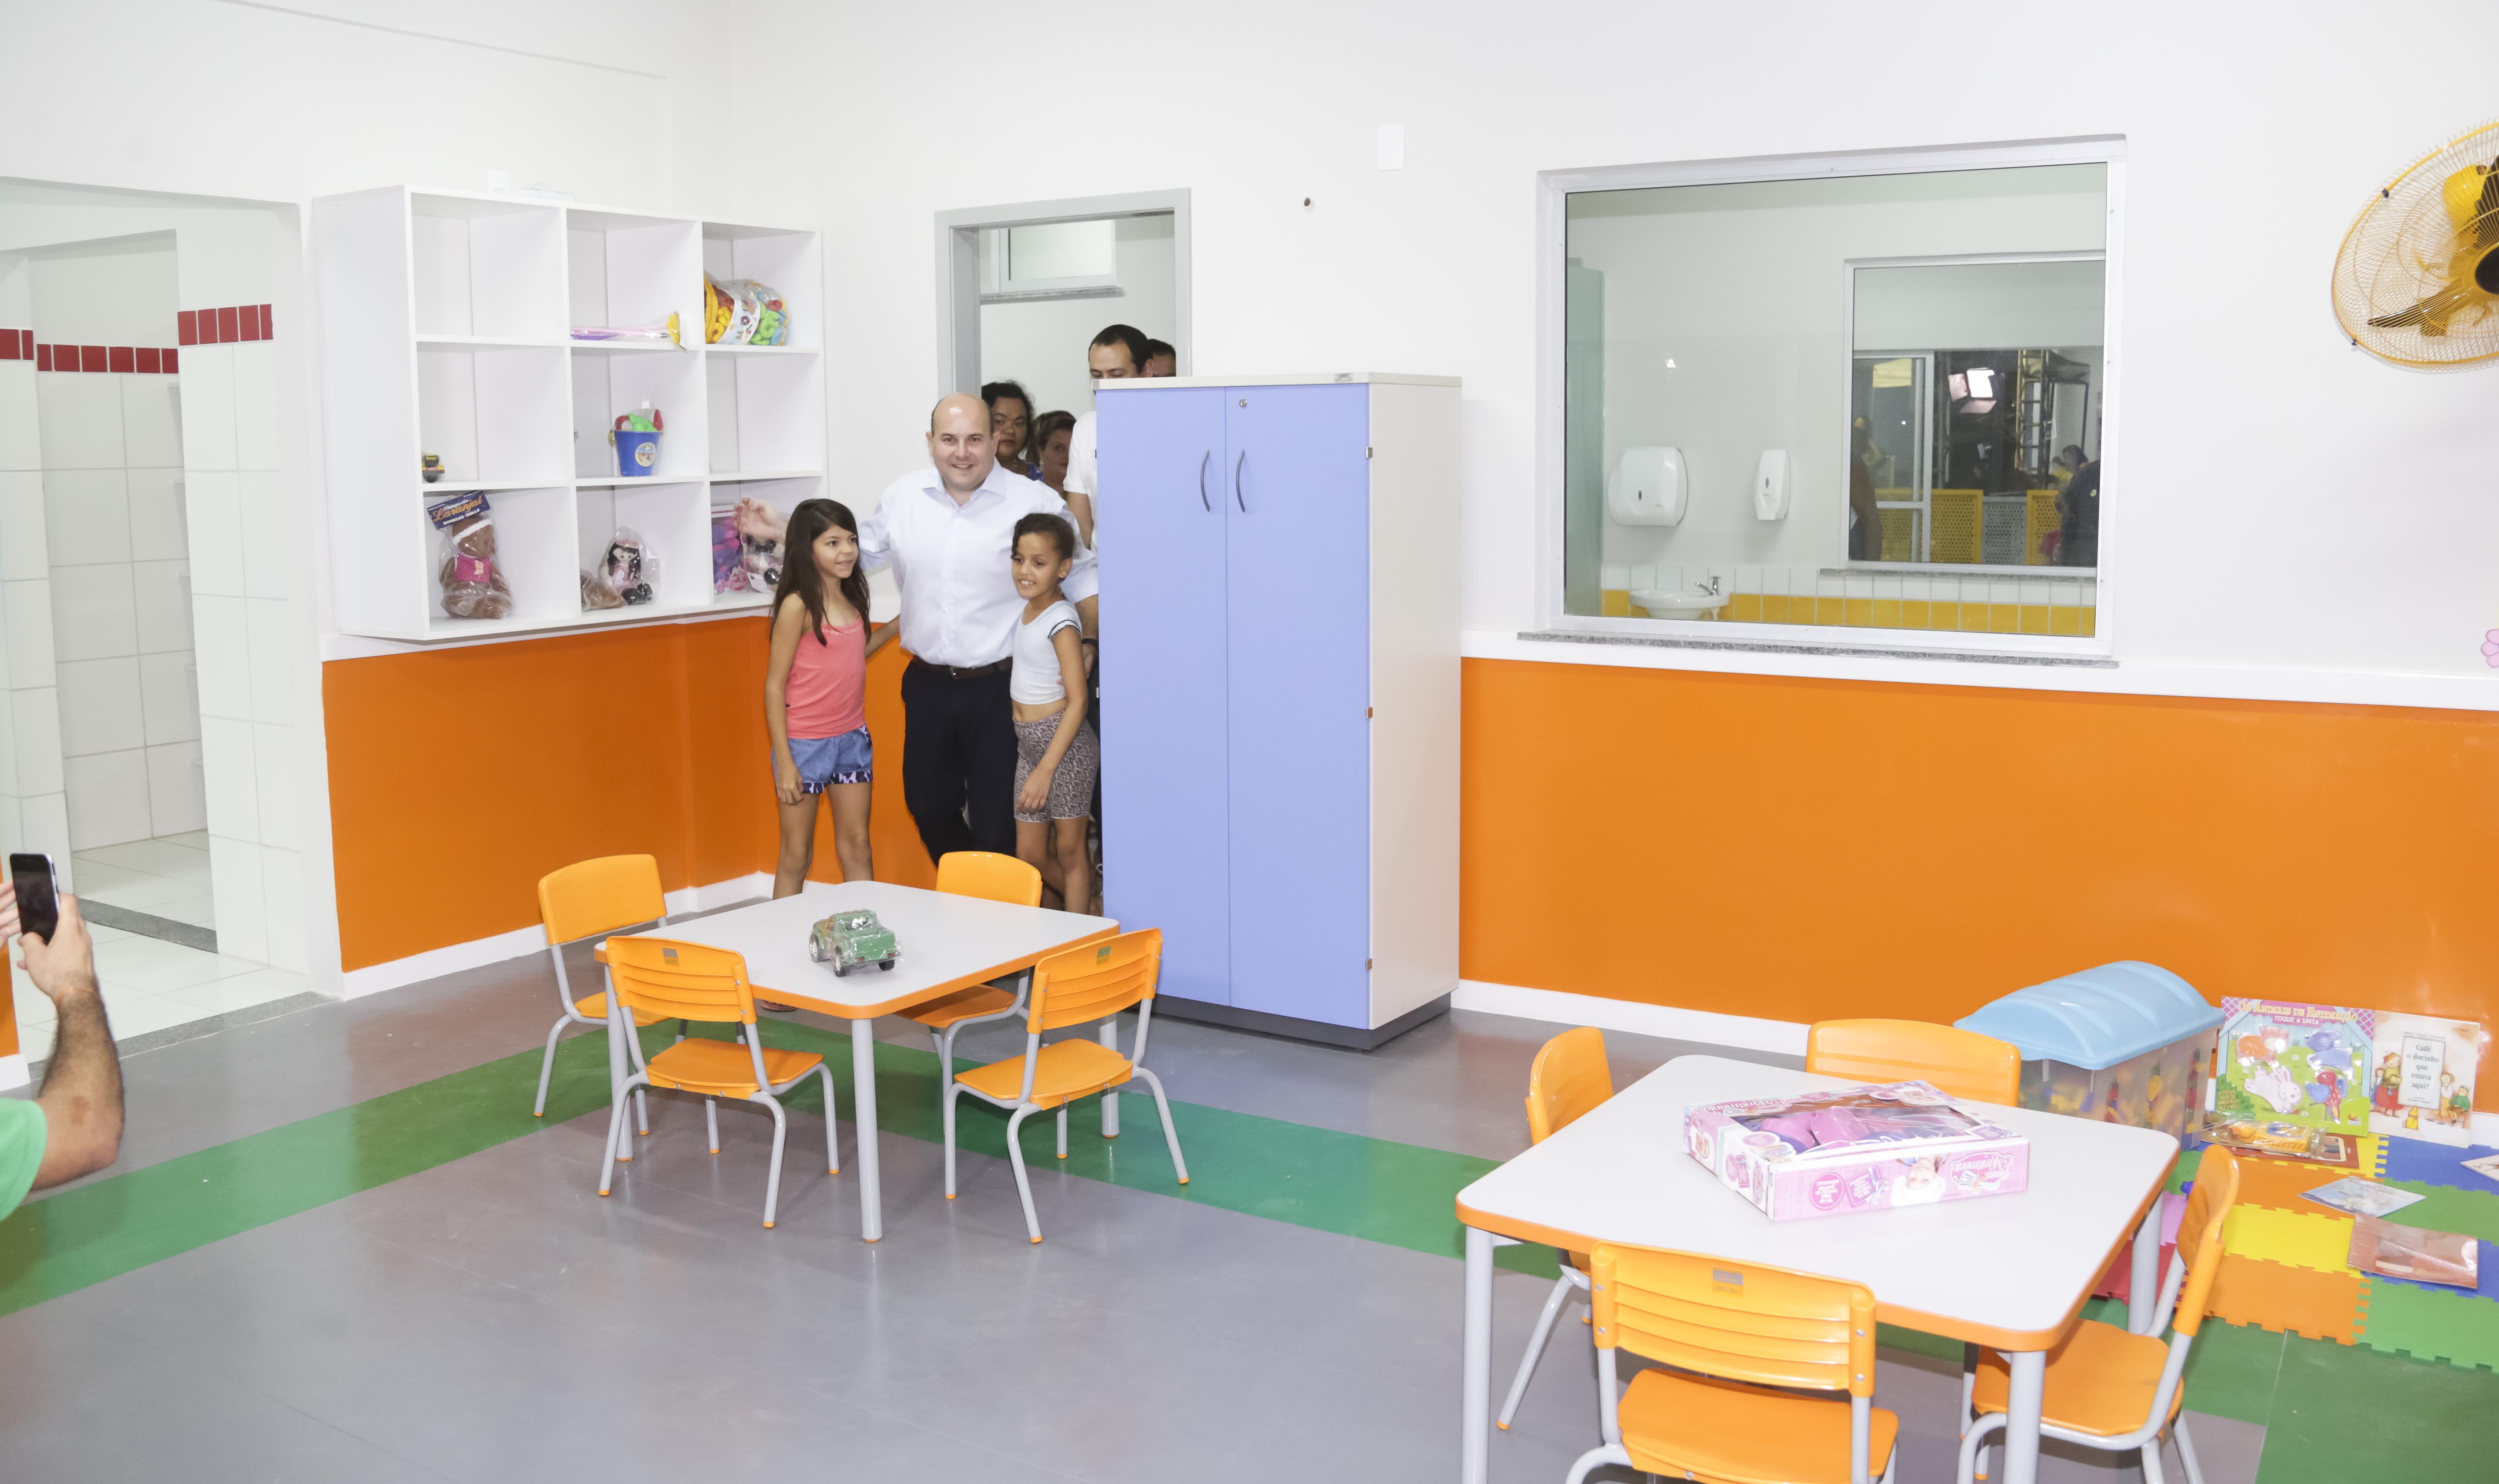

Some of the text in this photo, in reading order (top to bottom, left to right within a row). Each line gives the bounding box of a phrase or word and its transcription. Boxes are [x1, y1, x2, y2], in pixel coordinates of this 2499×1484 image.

[432, 495, 483, 522] Laranjal
[443, 508, 480, 525] BONECAS DOLLS
[2413, 1053, 2439, 1062] docinho
